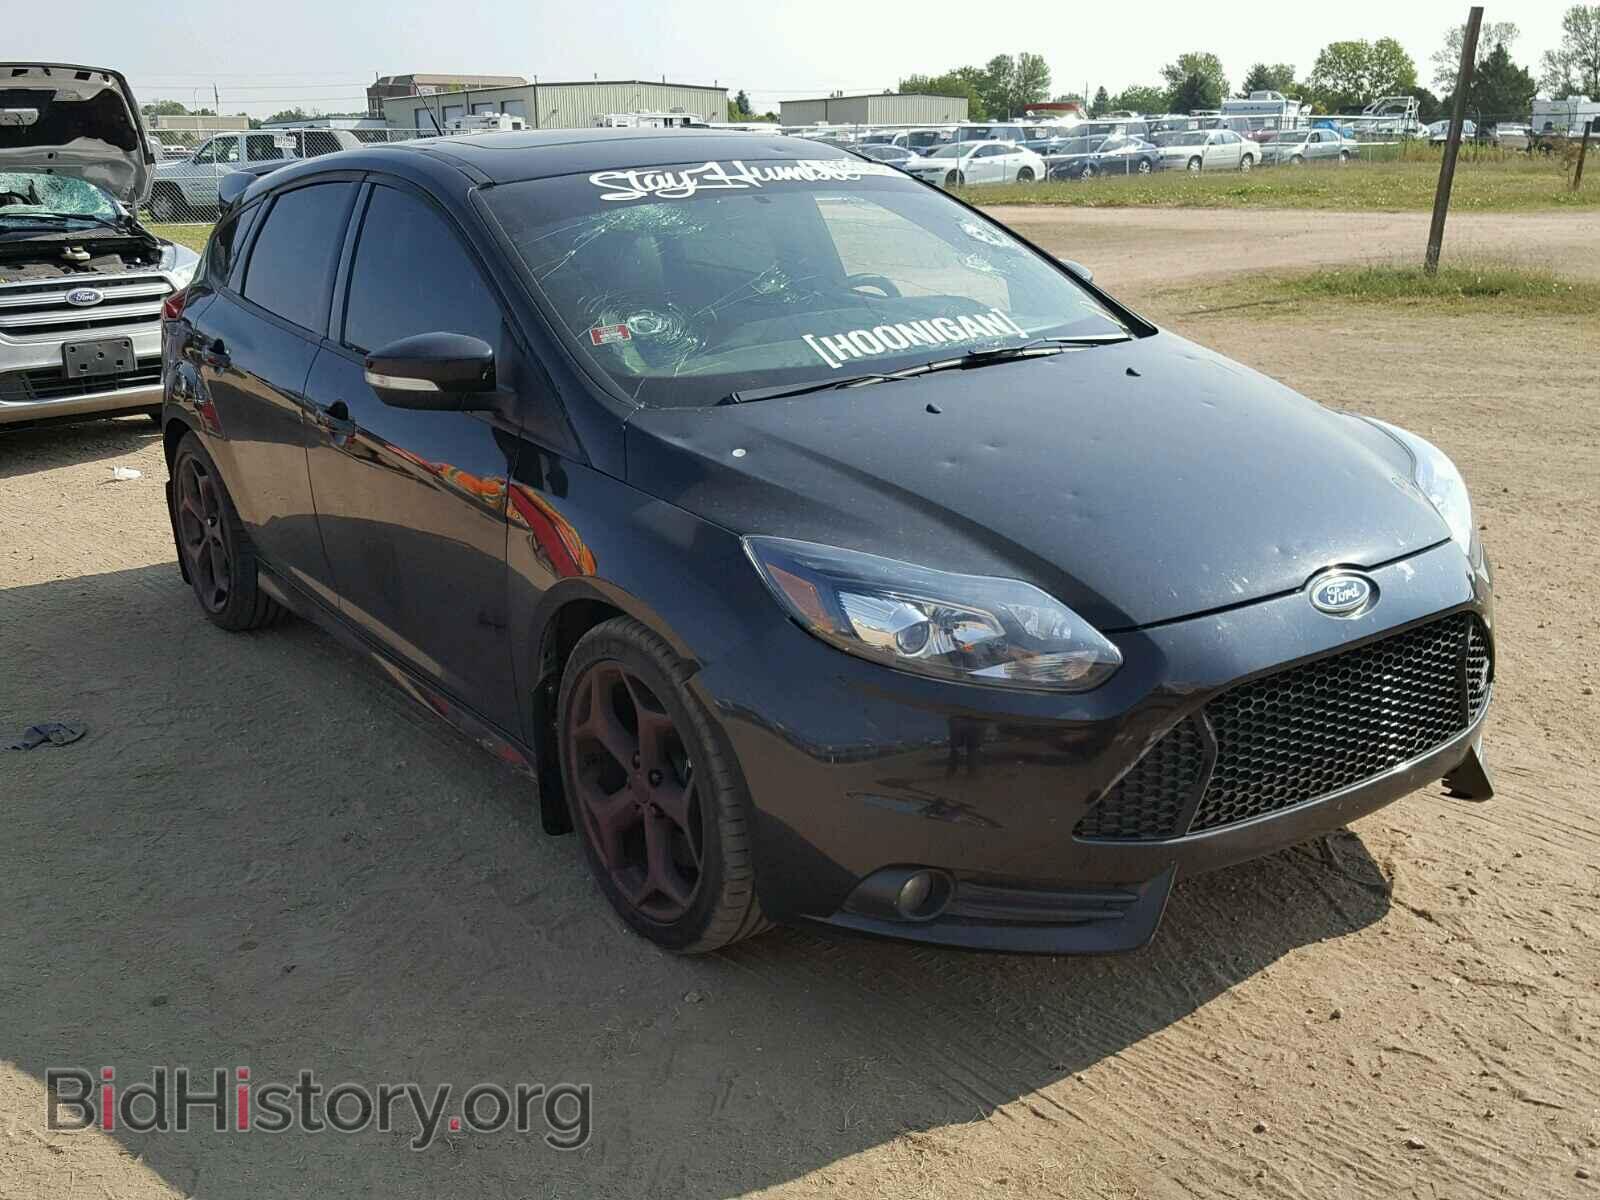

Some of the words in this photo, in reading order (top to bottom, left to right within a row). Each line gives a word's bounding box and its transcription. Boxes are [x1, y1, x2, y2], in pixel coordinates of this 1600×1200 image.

[589, 169, 702, 201] Stay
[76, 291, 96, 301] Ford
[1326, 582, 1360, 604] Ford
